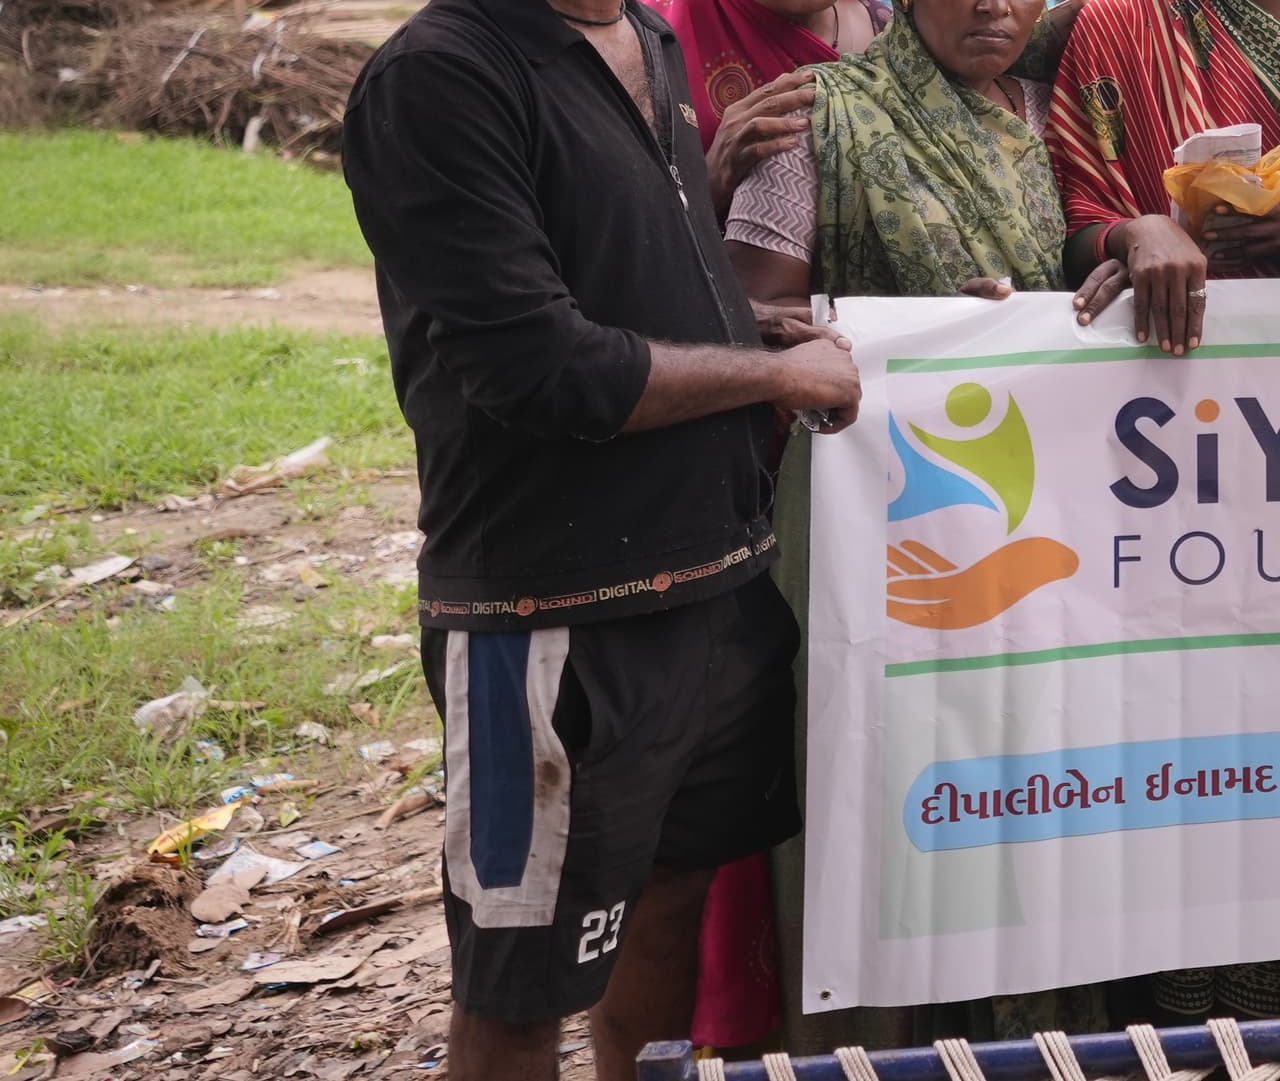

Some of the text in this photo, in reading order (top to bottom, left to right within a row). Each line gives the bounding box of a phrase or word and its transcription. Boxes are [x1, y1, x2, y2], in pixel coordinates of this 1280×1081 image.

[472, 600, 517, 615] DIGITAL
[540, 594, 593, 610] SOUND
[599, 578, 655, 601] DIGITAL
[675, 563, 721, 583] SOUND
[920, 768, 1126, 825] દીપાલીબેન
[577, 900, 626, 964] 23
